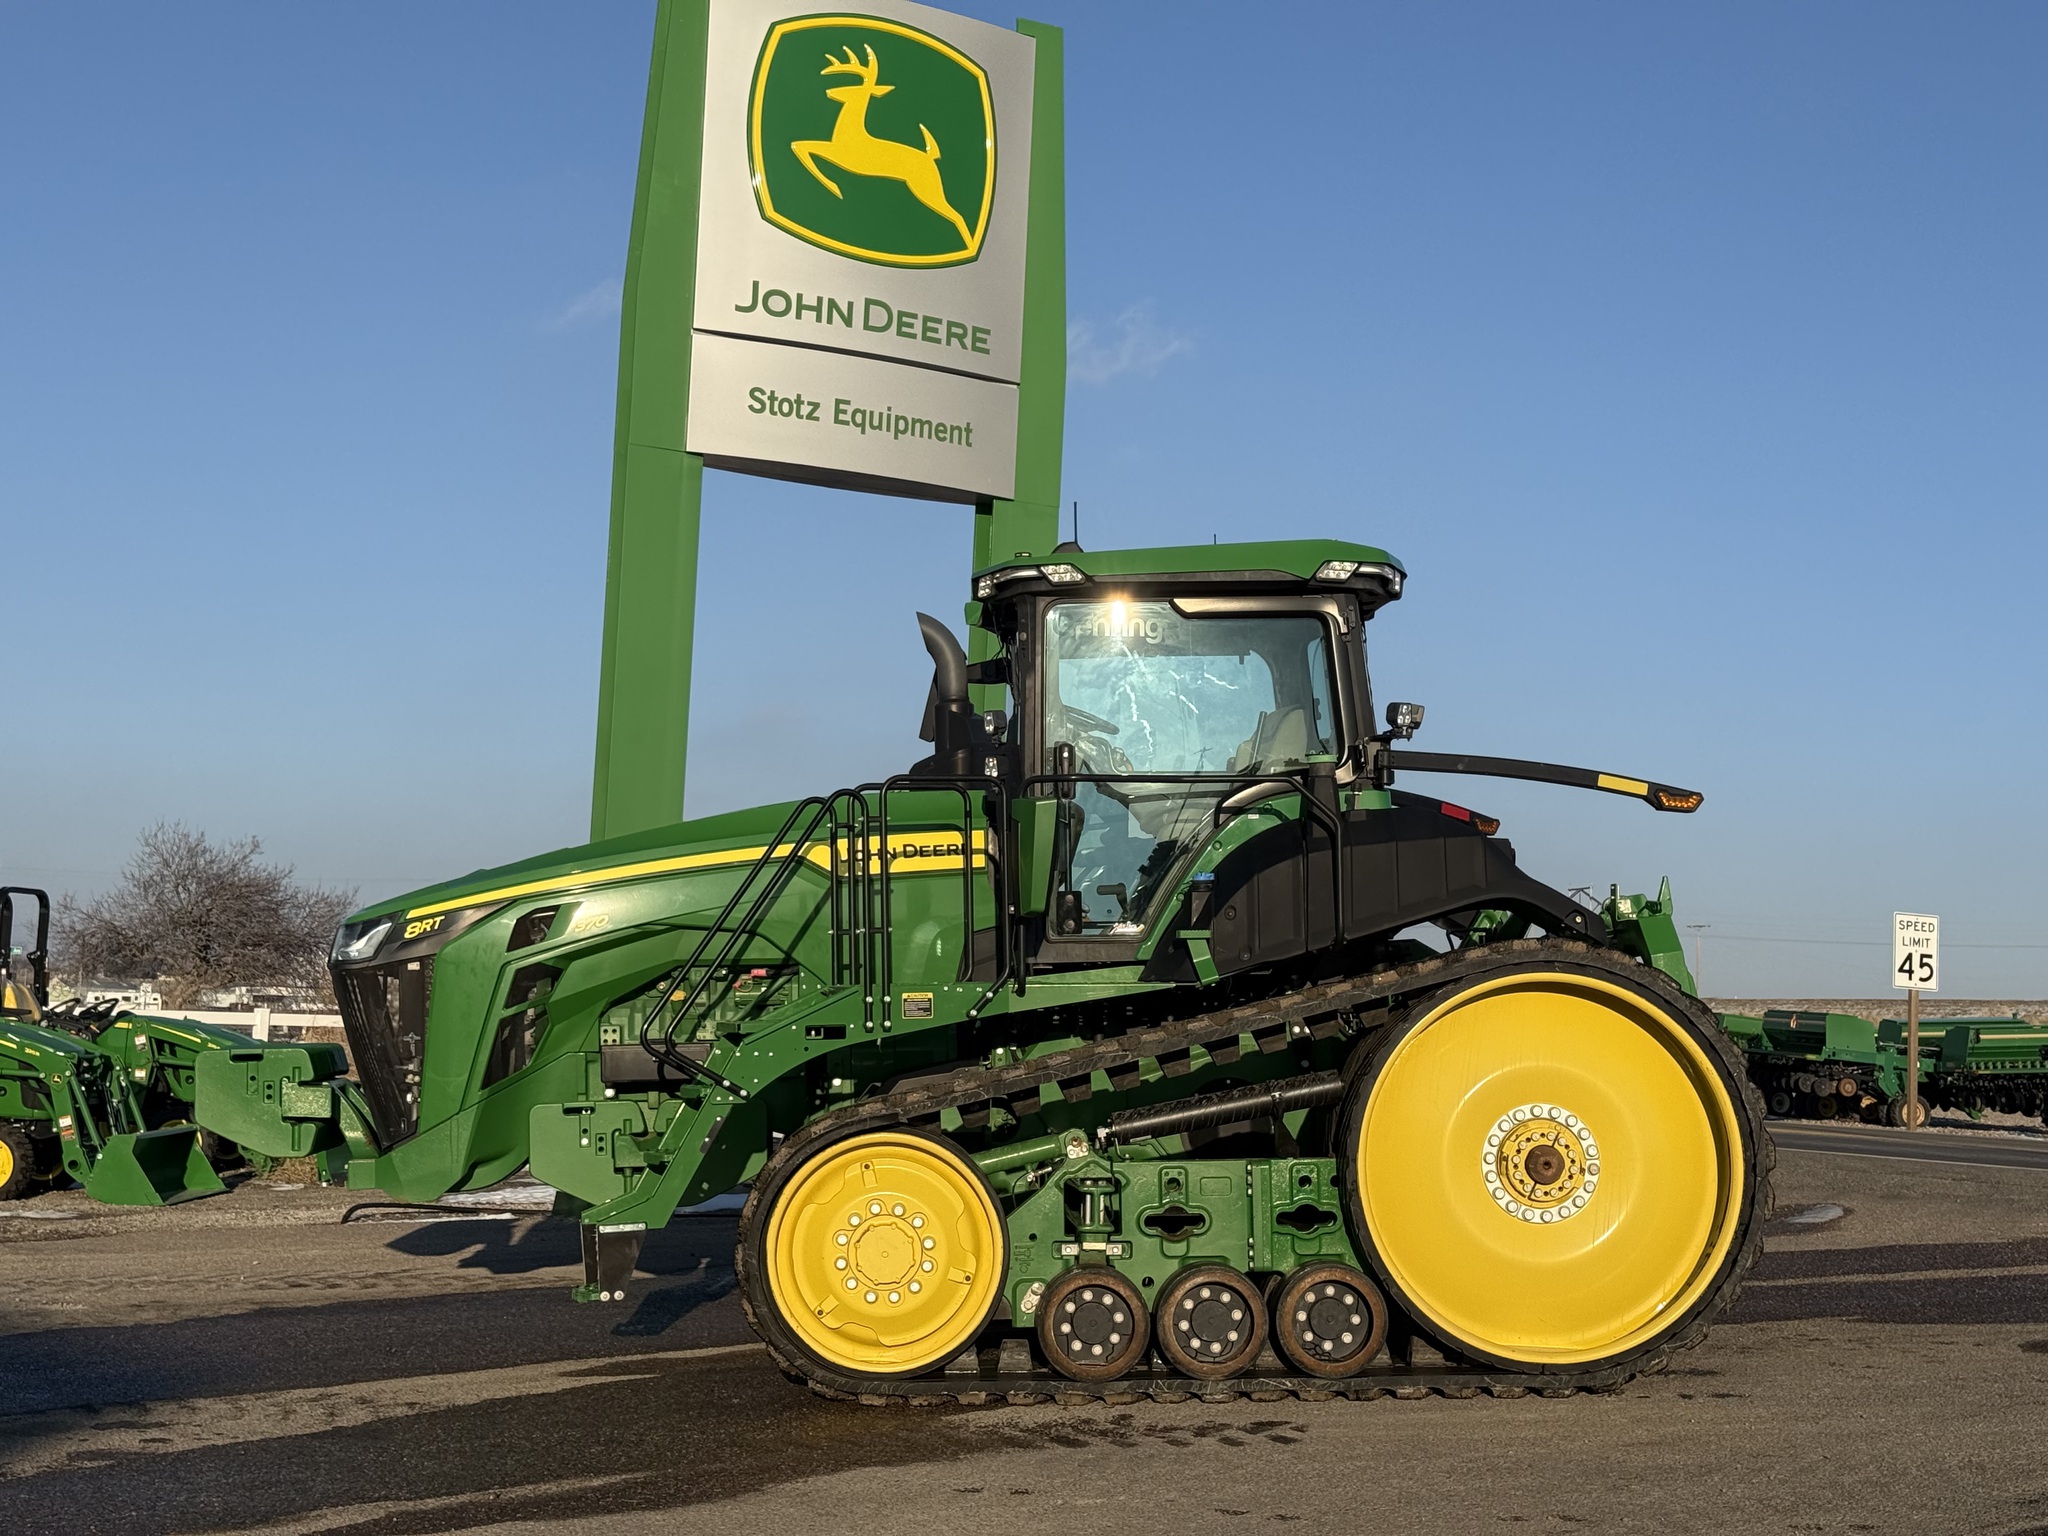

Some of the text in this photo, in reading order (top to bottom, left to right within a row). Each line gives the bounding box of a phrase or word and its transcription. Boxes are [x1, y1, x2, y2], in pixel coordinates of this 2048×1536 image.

[735, 280, 991, 355] JOHN DEERE
[748, 387, 973, 447] Stotz Equipment
[404, 915, 446, 939] 8RT
[1899, 920, 1935, 933] SPEED
[1902, 936, 1931, 948] LIMIT
[1898, 952, 1934, 983] 45
